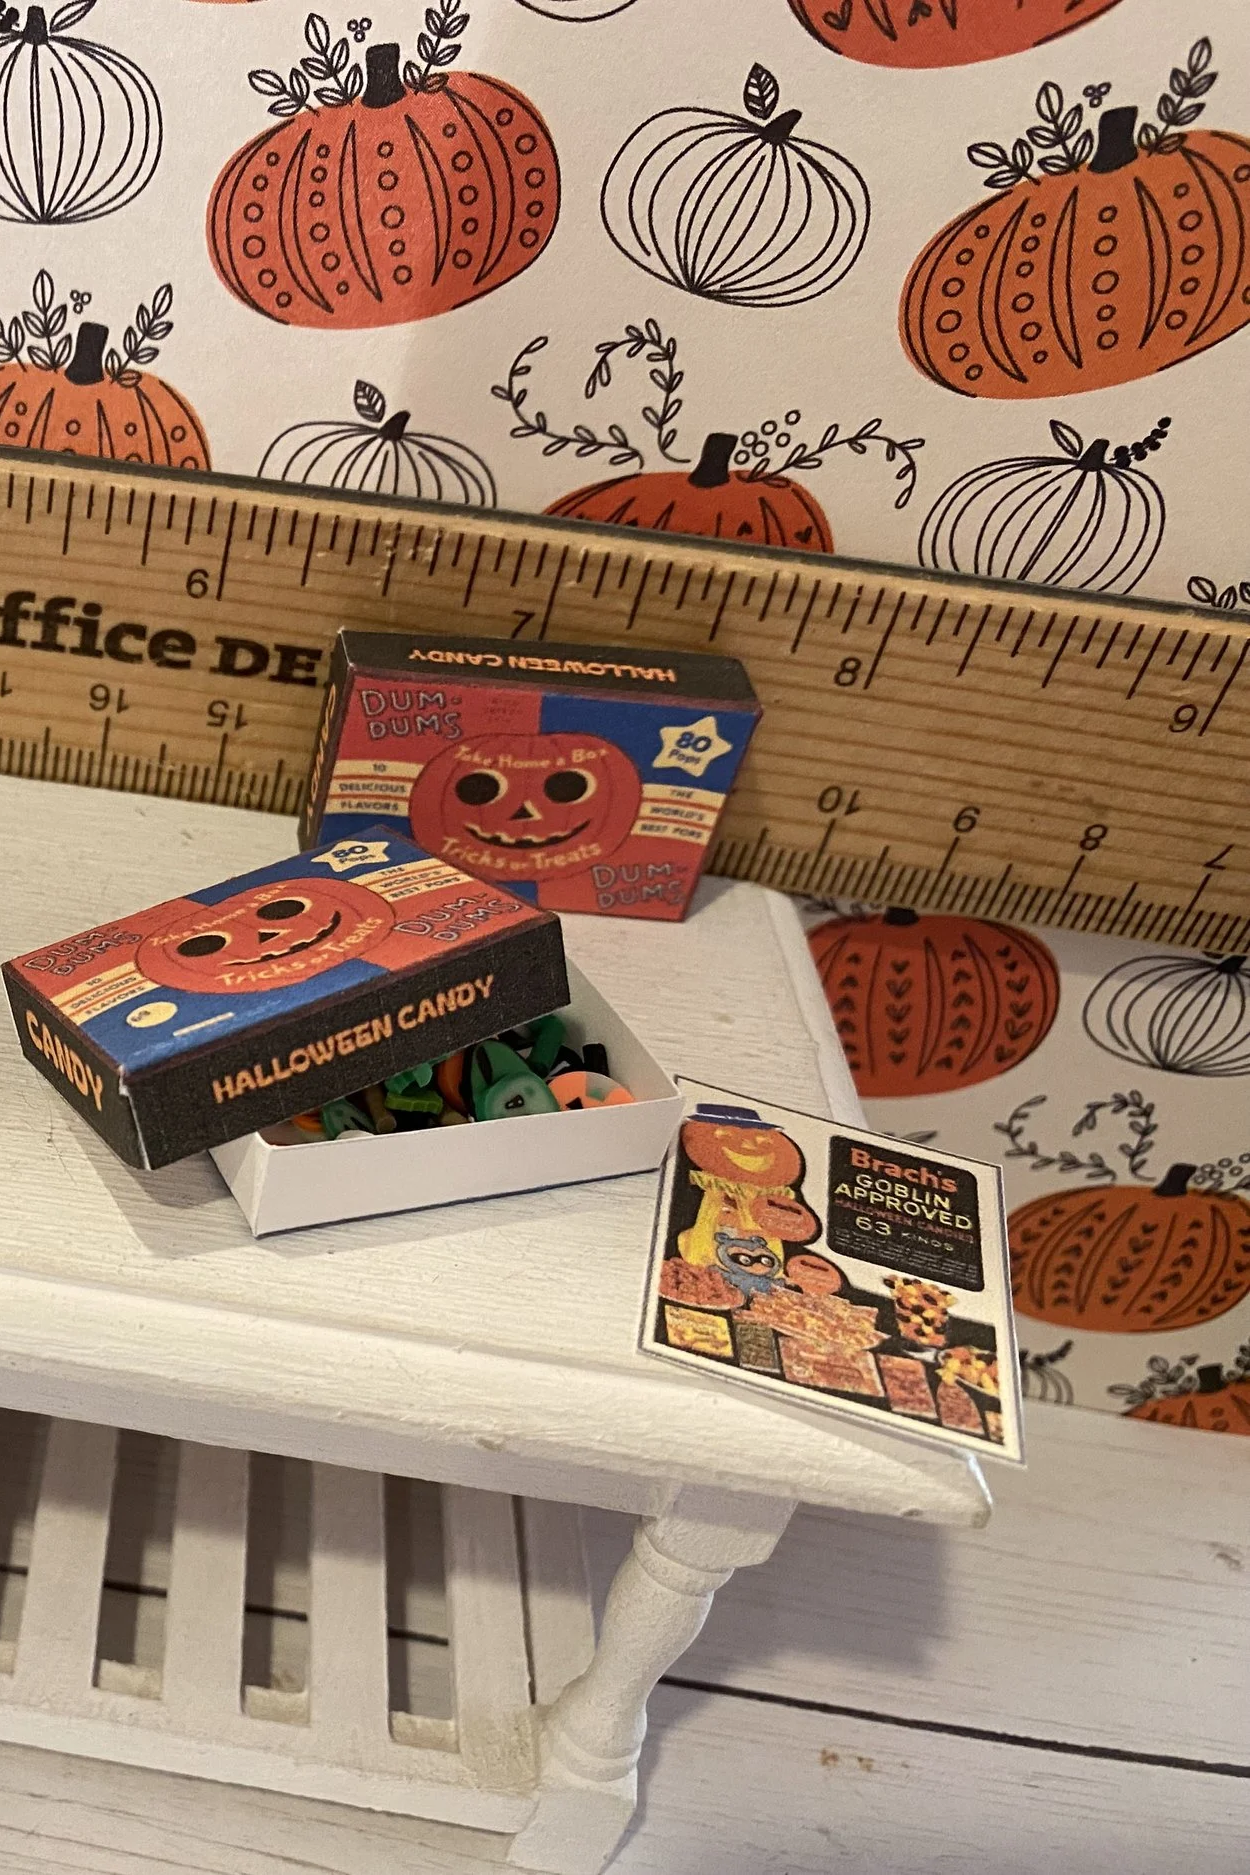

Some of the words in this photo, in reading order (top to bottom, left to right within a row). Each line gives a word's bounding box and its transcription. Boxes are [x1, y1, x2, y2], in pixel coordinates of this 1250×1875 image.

[186, 568, 209, 599] 6
[511, 609, 536, 640] 7
[210, 635, 324, 688] DE
[409, 649, 503, 668] CANDY
[509, 655, 677, 683] HALLOWEEN
[834, 657, 862, 688] 8
[88, 682, 131, 714] 16
[206, 700, 249, 732] 15
[368, 712, 462, 741] DUMS
[1168, 703, 1199, 734] 9
[675, 731, 712, 753] 80
[372, 763, 387, 774] 10
[455, 745, 493, 766] Take
[499, 753, 551, 769] Home
[339, 783, 407, 795] DELICIOUS
[669, 789, 694, 799] THE
[817, 785, 863, 816] 10
[340, 800, 400, 812] FLAVORS
[953, 806, 981, 833] 9
[640, 823, 667, 835] BEST
[1079, 823, 1108, 851] 8
[331, 845, 369, 858] 80
[441, 836, 507, 869] Tricks
[509, 861, 530, 871] or
[530, 843, 602, 869] Treats
[1203, 844, 1235, 870] 7
[380, 866, 405, 877] THE
[389, 886, 420, 898] BEST
[596, 879, 687, 909] DUMS
[432, 898, 522, 942] DUMS
[318, 916, 384, 953] Treats
[52, 930, 143, 976] DUMS
[310, 953, 329, 965] or
[214, 960, 307, 987] Tricks
[70, 976, 137, 1009] DELICIOUS
[84, 986, 146, 1014] FLAVORS
[212, 1012, 393, 1104] HALLOWEEN
[396, 975, 494, 1025] CANDY
[25, 1009, 105, 1111] CANDY
[856, 1173, 951, 1210] GOBLIN
[834, 1182, 973, 1230] APPROVED
[855, 1216, 892, 1236] 63
